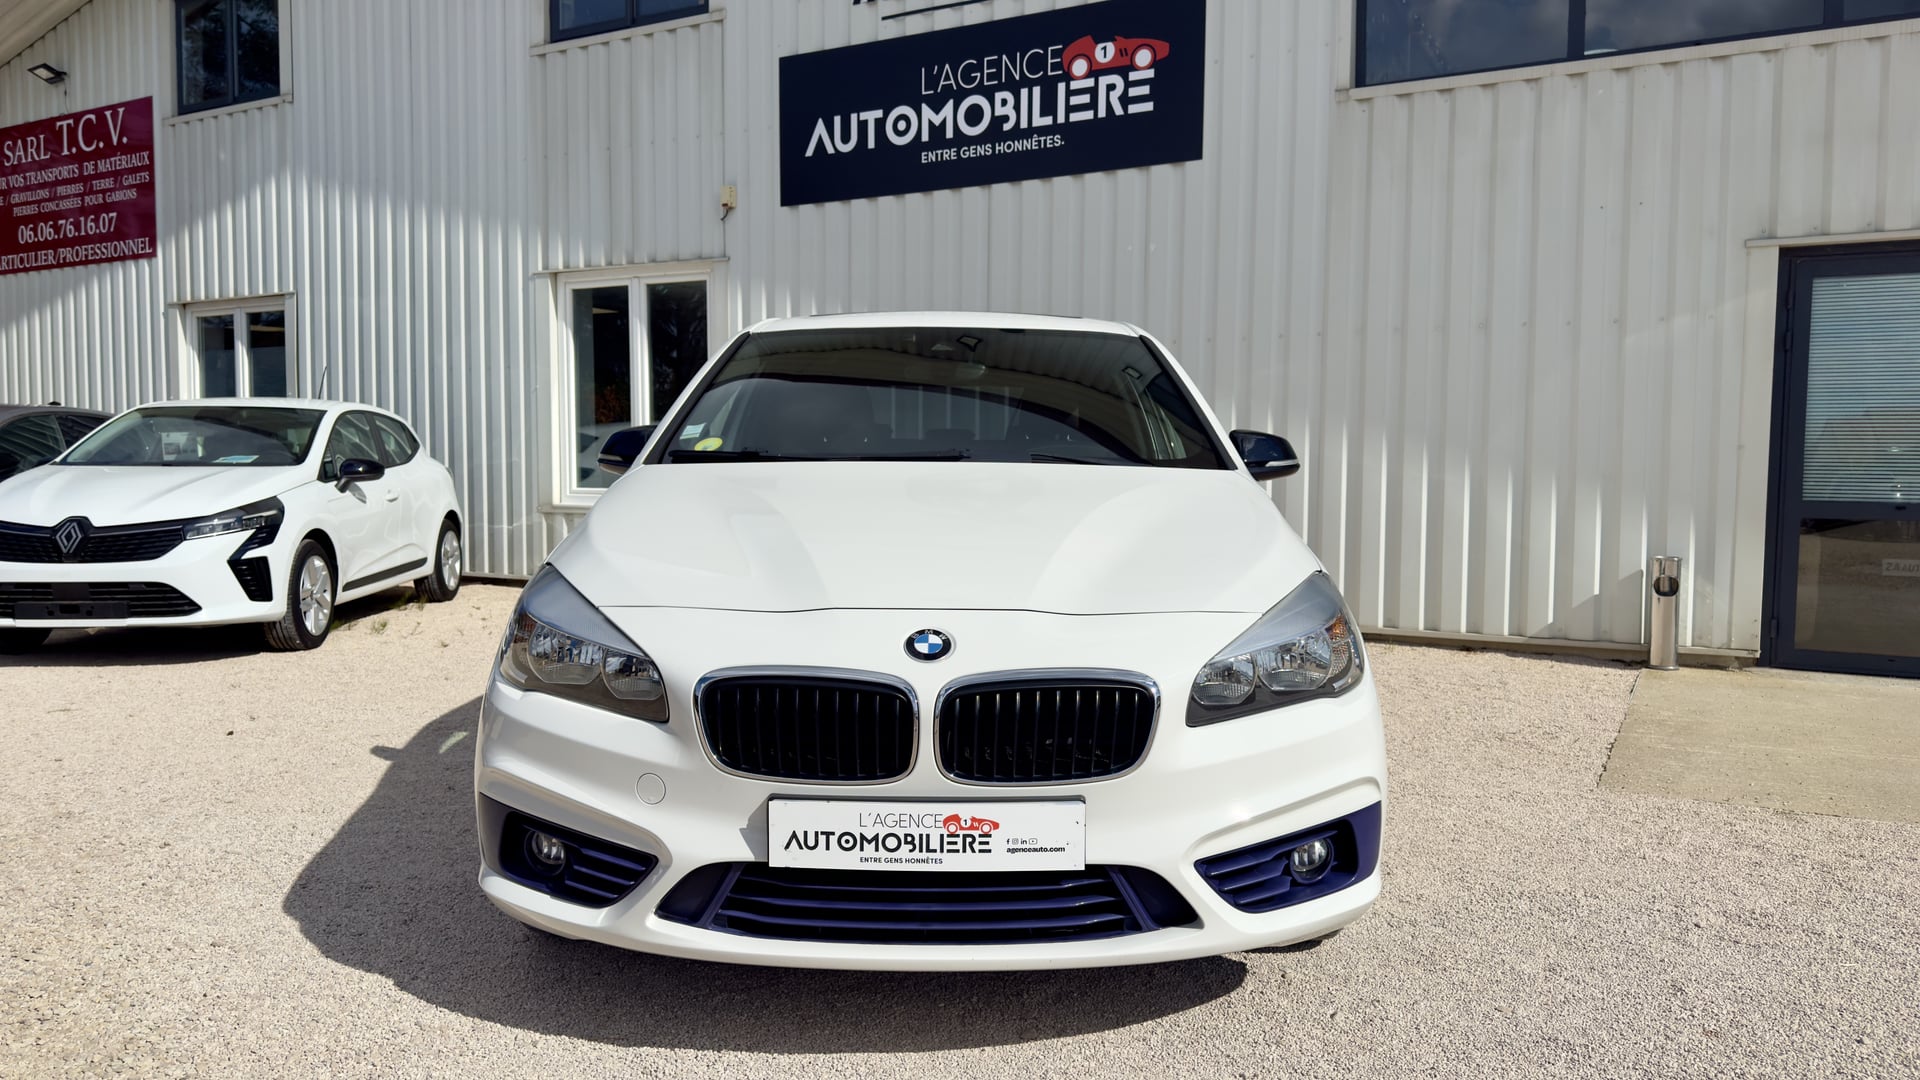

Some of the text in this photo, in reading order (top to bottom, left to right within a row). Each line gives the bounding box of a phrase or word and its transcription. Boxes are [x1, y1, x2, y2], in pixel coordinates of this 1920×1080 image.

[920, 44, 1064, 96] L'AGENCE
[3, 107, 128, 167] SARL T.C.V.
[921, 133, 1065, 164] ENTRE GENS HONNÊTES.
[8, 174, 25, 189] VOS
[25, 164, 79, 185] TRANSPORTS
[83, 162, 95, 176] DE
[97, 151, 150, 173] MATÉRIAUX
[10, 188, 49, 204] GRAVILLONS
[56, 183, 84, 197] PIERRES
[92, 177, 115, 191] TERRE
[122, 171, 150, 187] GALETS
[13, 188, 137, 217] PIERRES CONCASSÉES POUR GABIONS
[18, 212, 118, 245] 06.06.76.16.07
[859, 812, 944, 829] L'AGENCE
[860, 856, 883, 864] ENTRE
[884, 856, 904, 865] GENS
